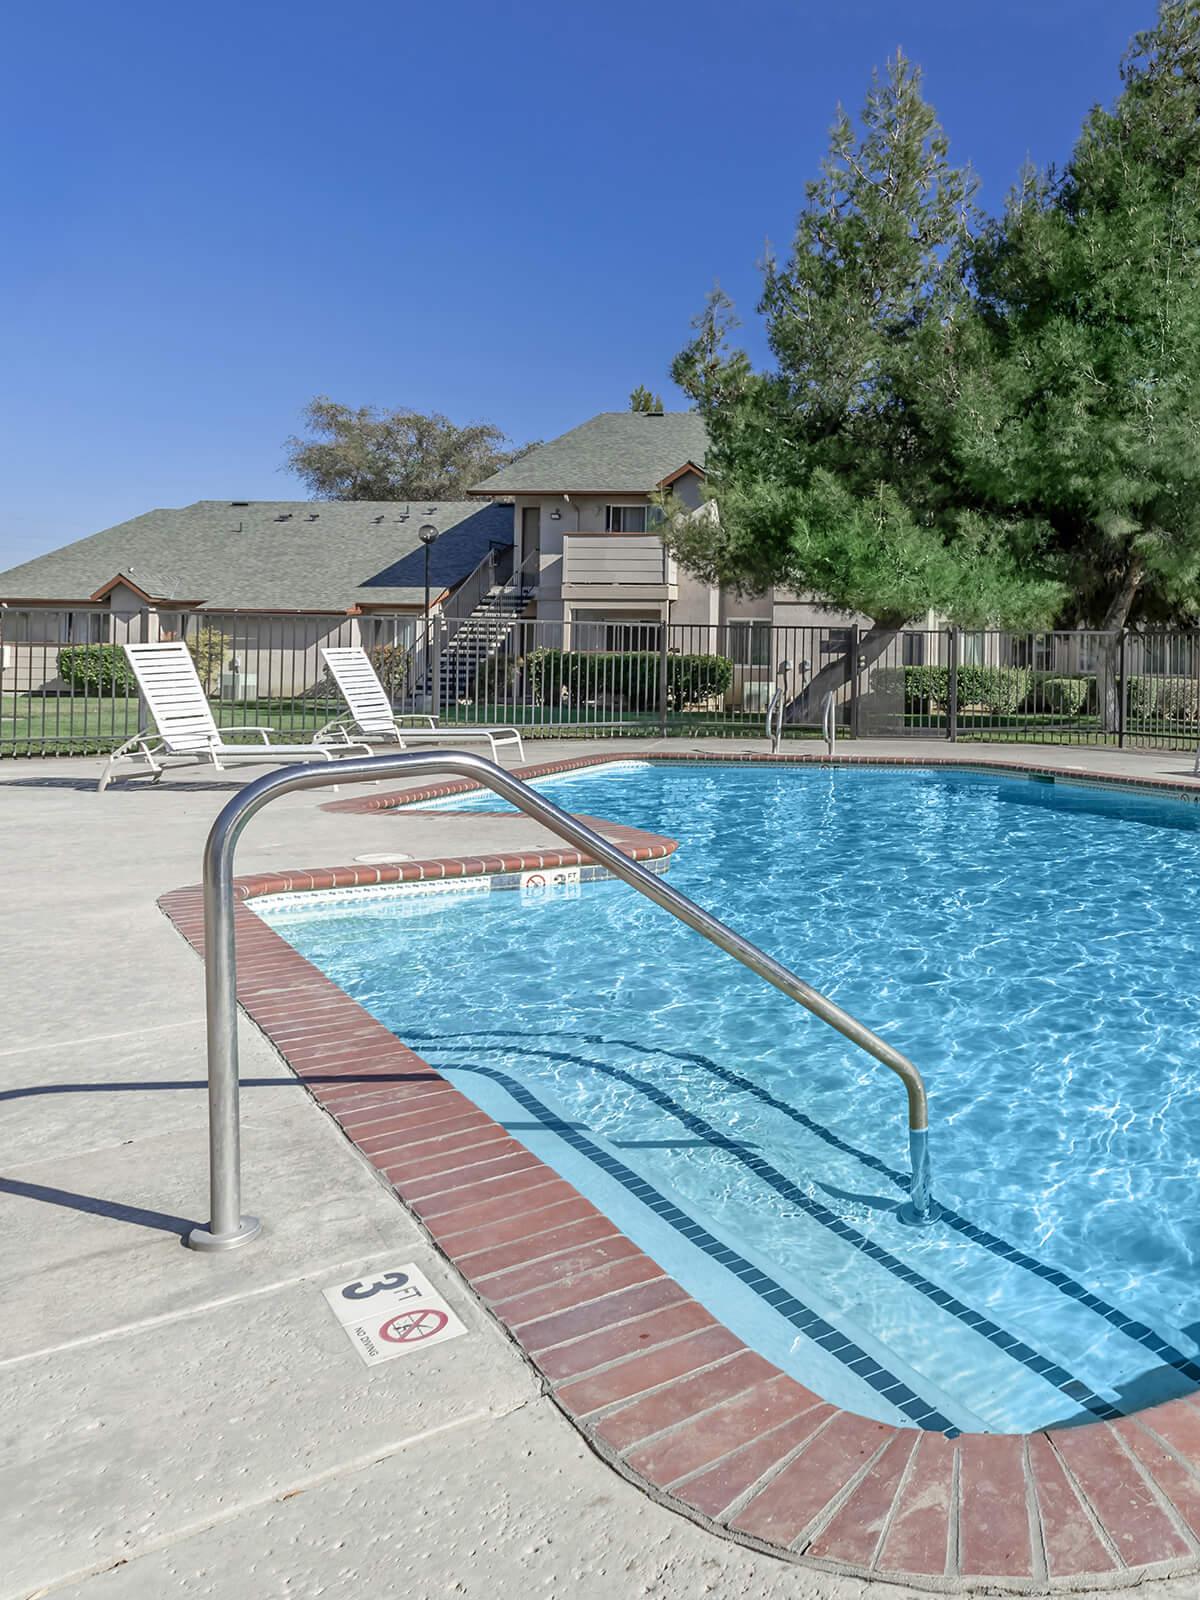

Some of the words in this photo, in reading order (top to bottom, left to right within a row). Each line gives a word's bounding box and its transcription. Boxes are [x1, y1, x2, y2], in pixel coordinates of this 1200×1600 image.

[341, 1272, 409, 1300] 3
[393, 1285, 422, 1301] FT
[353, 1326, 367, 1336] NO
[359, 1335, 379, 1357] DIVING
